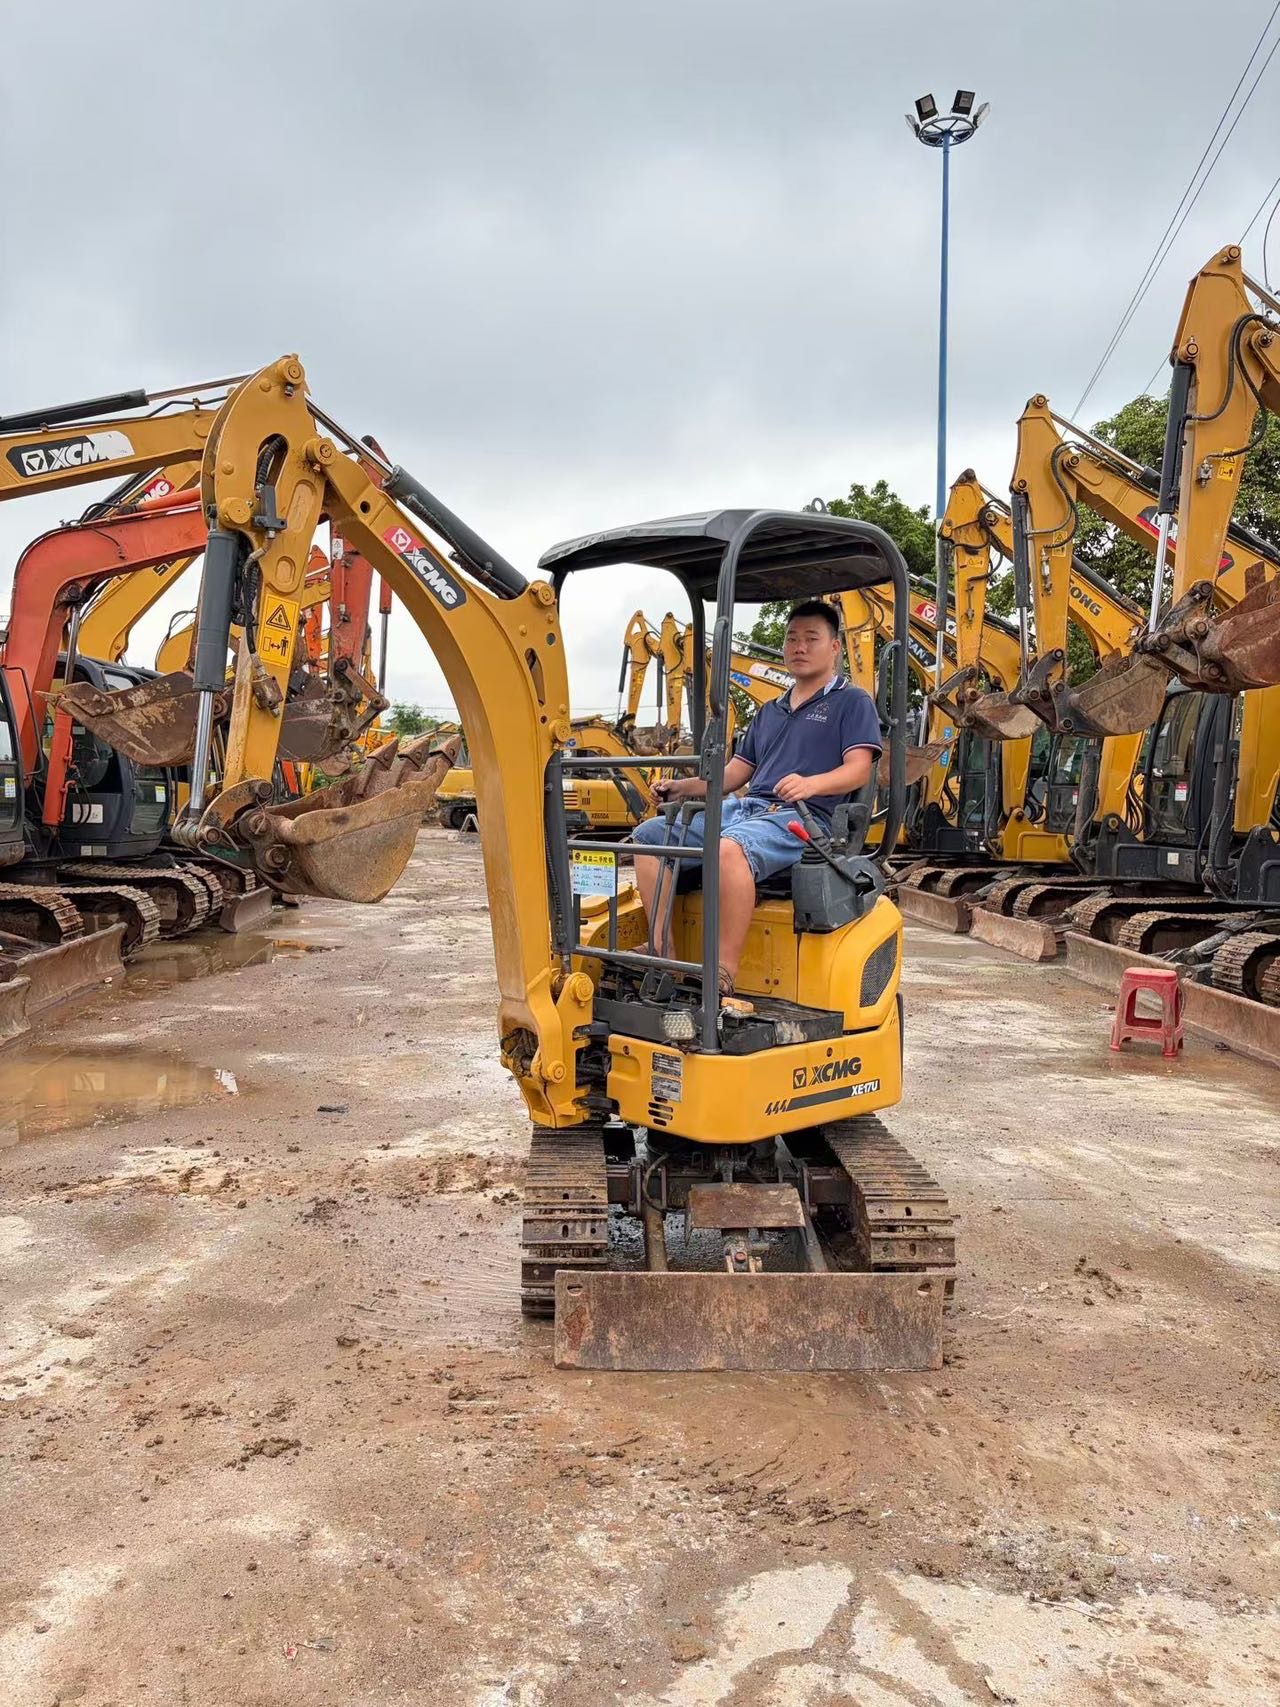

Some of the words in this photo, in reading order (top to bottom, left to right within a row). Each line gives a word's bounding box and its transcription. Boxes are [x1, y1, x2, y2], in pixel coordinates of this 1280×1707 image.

[48, 442, 110, 471] XCM
[404, 546, 458, 604] XCMG
[1070, 579, 1102, 616] ONG
[809, 1057, 862, 1087] XCMG
[851, 1080, 878, 1096] XE17U
